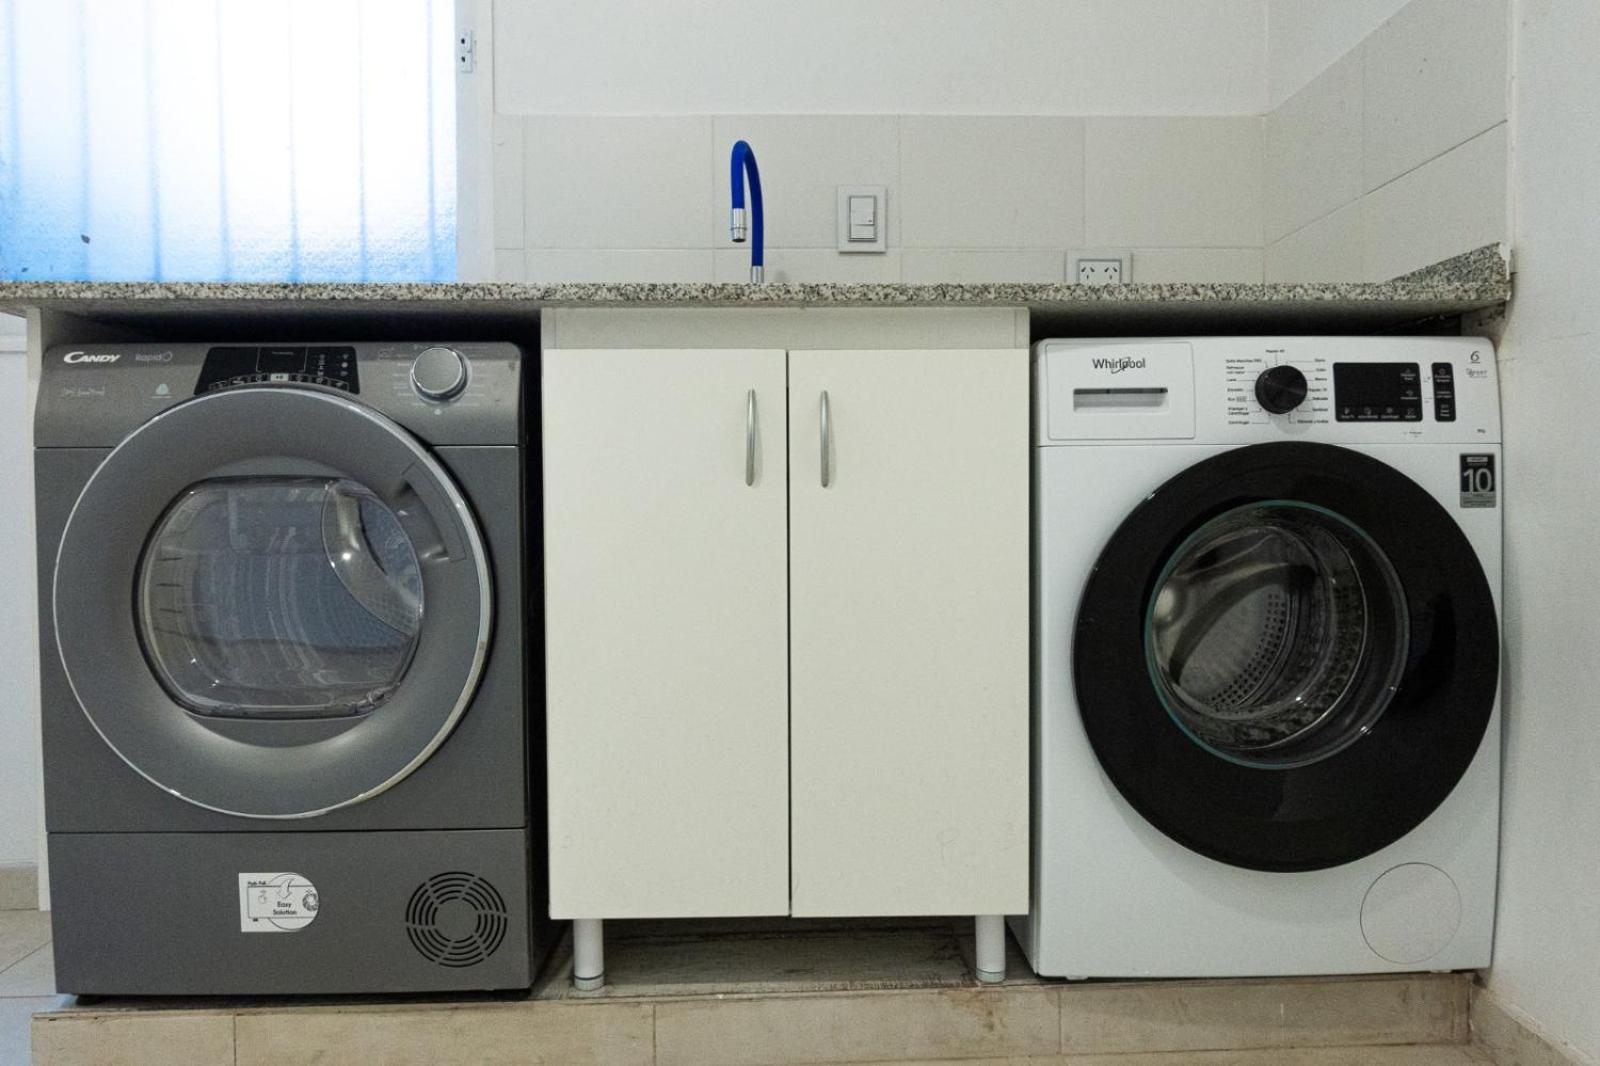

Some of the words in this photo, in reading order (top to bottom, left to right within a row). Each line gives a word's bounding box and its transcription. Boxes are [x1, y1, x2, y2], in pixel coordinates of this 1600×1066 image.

[63, 351, 121, 364] CANDY
[1092, 357, 1146, 373] Whirlpool
[1463, 468, 1492, 492] 10
